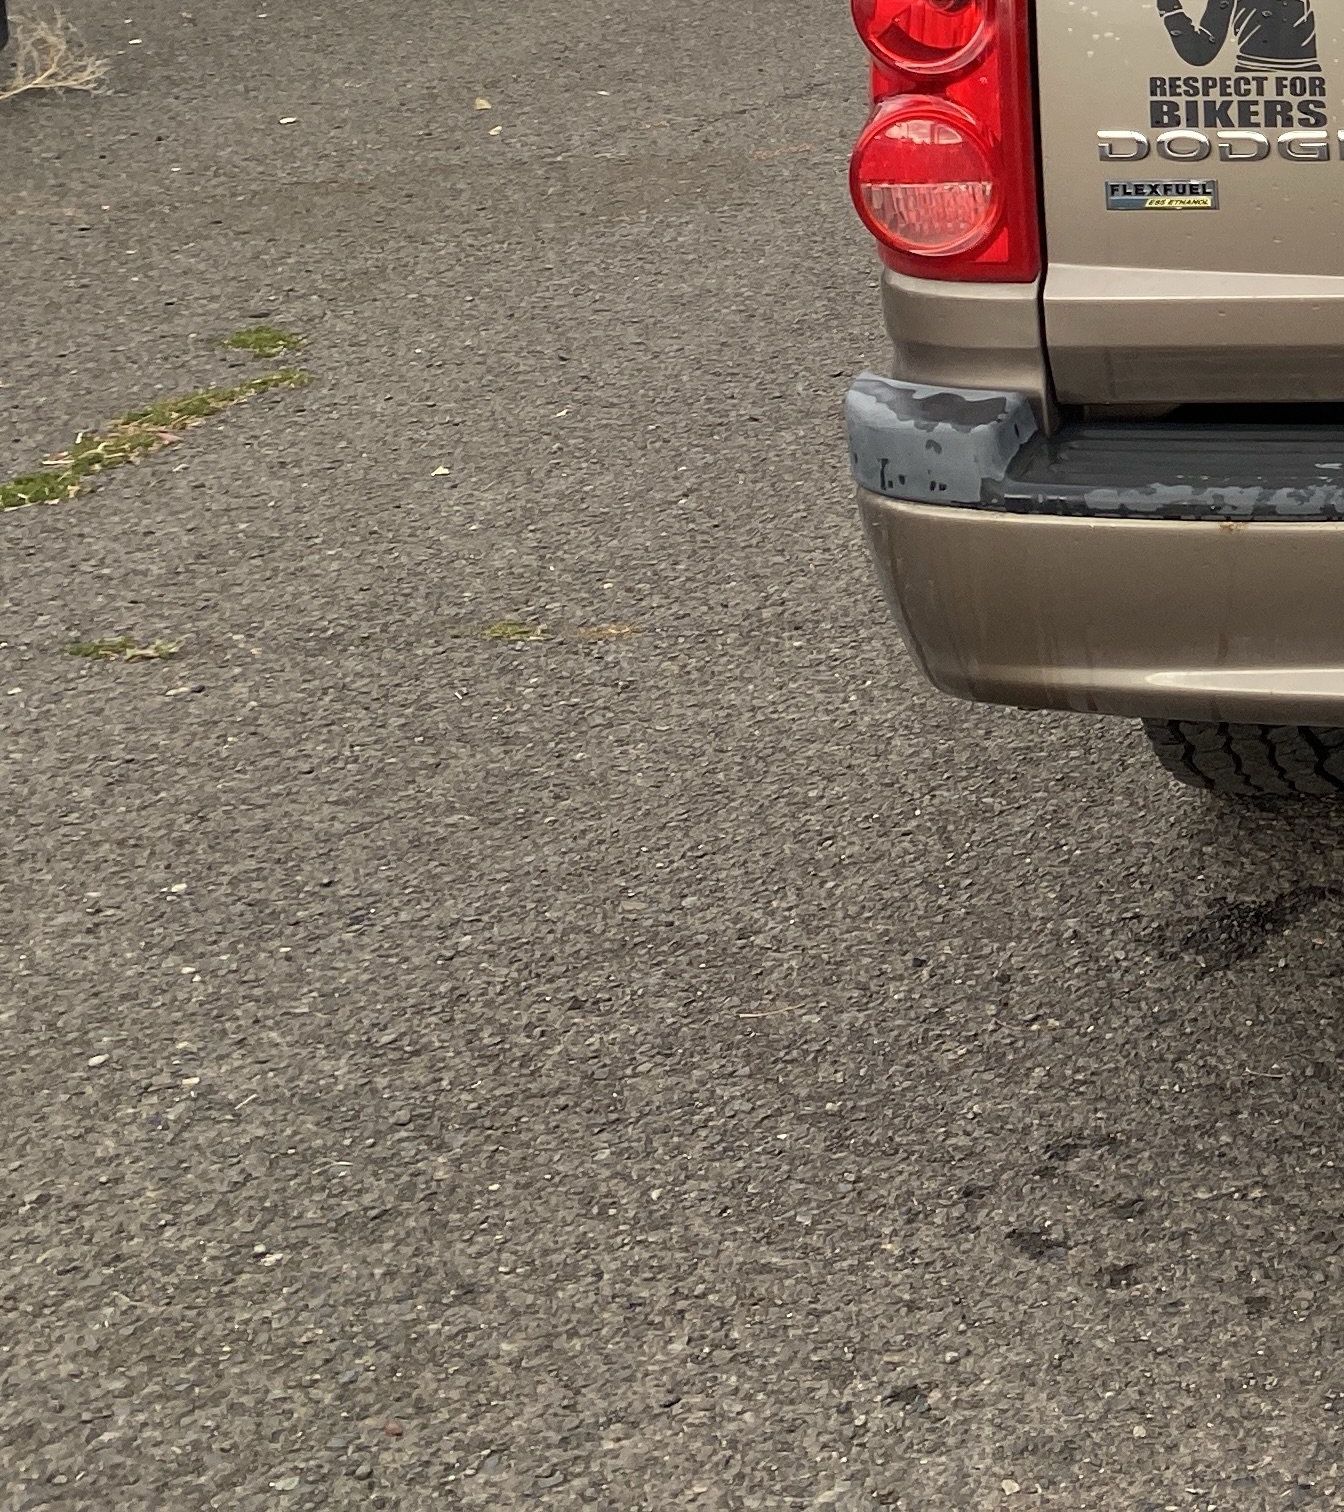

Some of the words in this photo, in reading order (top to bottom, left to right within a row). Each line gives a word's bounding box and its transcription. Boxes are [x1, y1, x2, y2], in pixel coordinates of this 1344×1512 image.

[1149, 76, 1268, 97] RESPECT
[1275, 76, 1327, 97] FOR
[1149, 100, 1328, 128] BIKERS
[1110, 183, 1212, 196] FLEXFUEL
